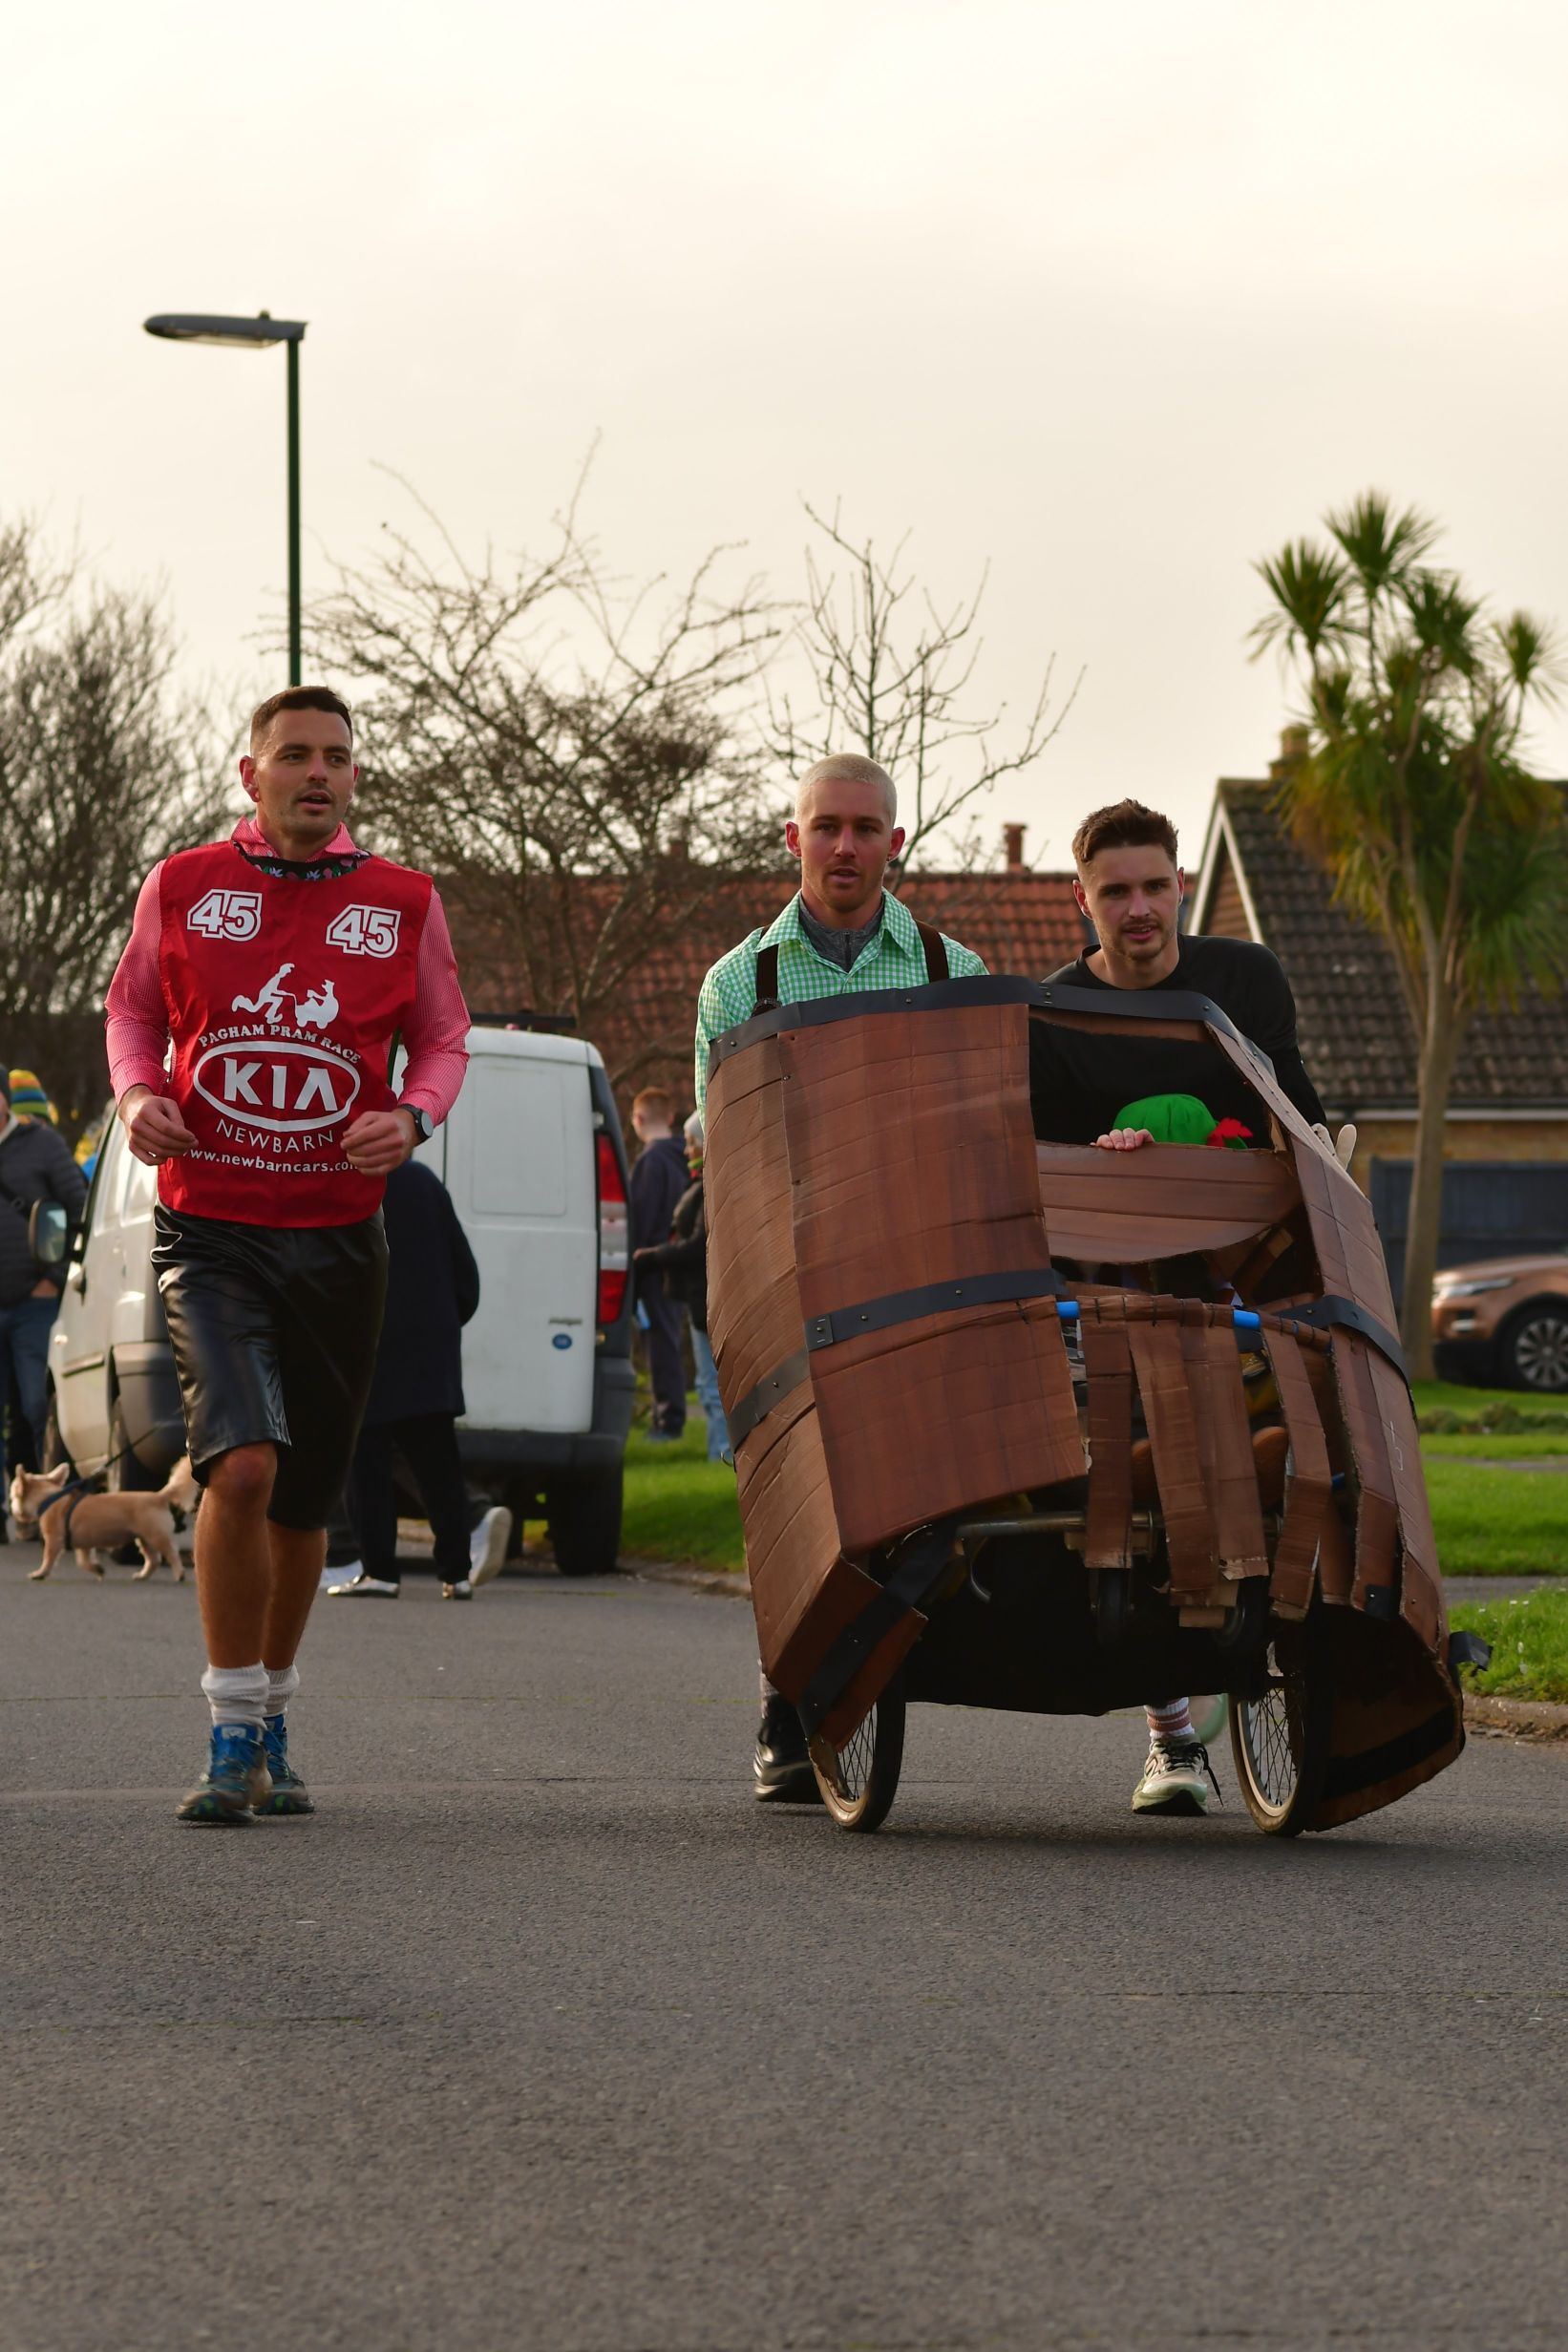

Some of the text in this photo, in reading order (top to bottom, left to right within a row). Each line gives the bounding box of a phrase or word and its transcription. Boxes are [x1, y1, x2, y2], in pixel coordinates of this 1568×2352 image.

[186, 888, 263, 942] 45
[325, 903, 402, 959] 45
[198, 1024, 362, 1064] PAGHAM PRAM RACE
[222, 1057, 339, 1112] KIA
[216, 1118, 333, 1154] NEWBARN
[182, 1149, 358, 1174] ww.newbarncars.co
